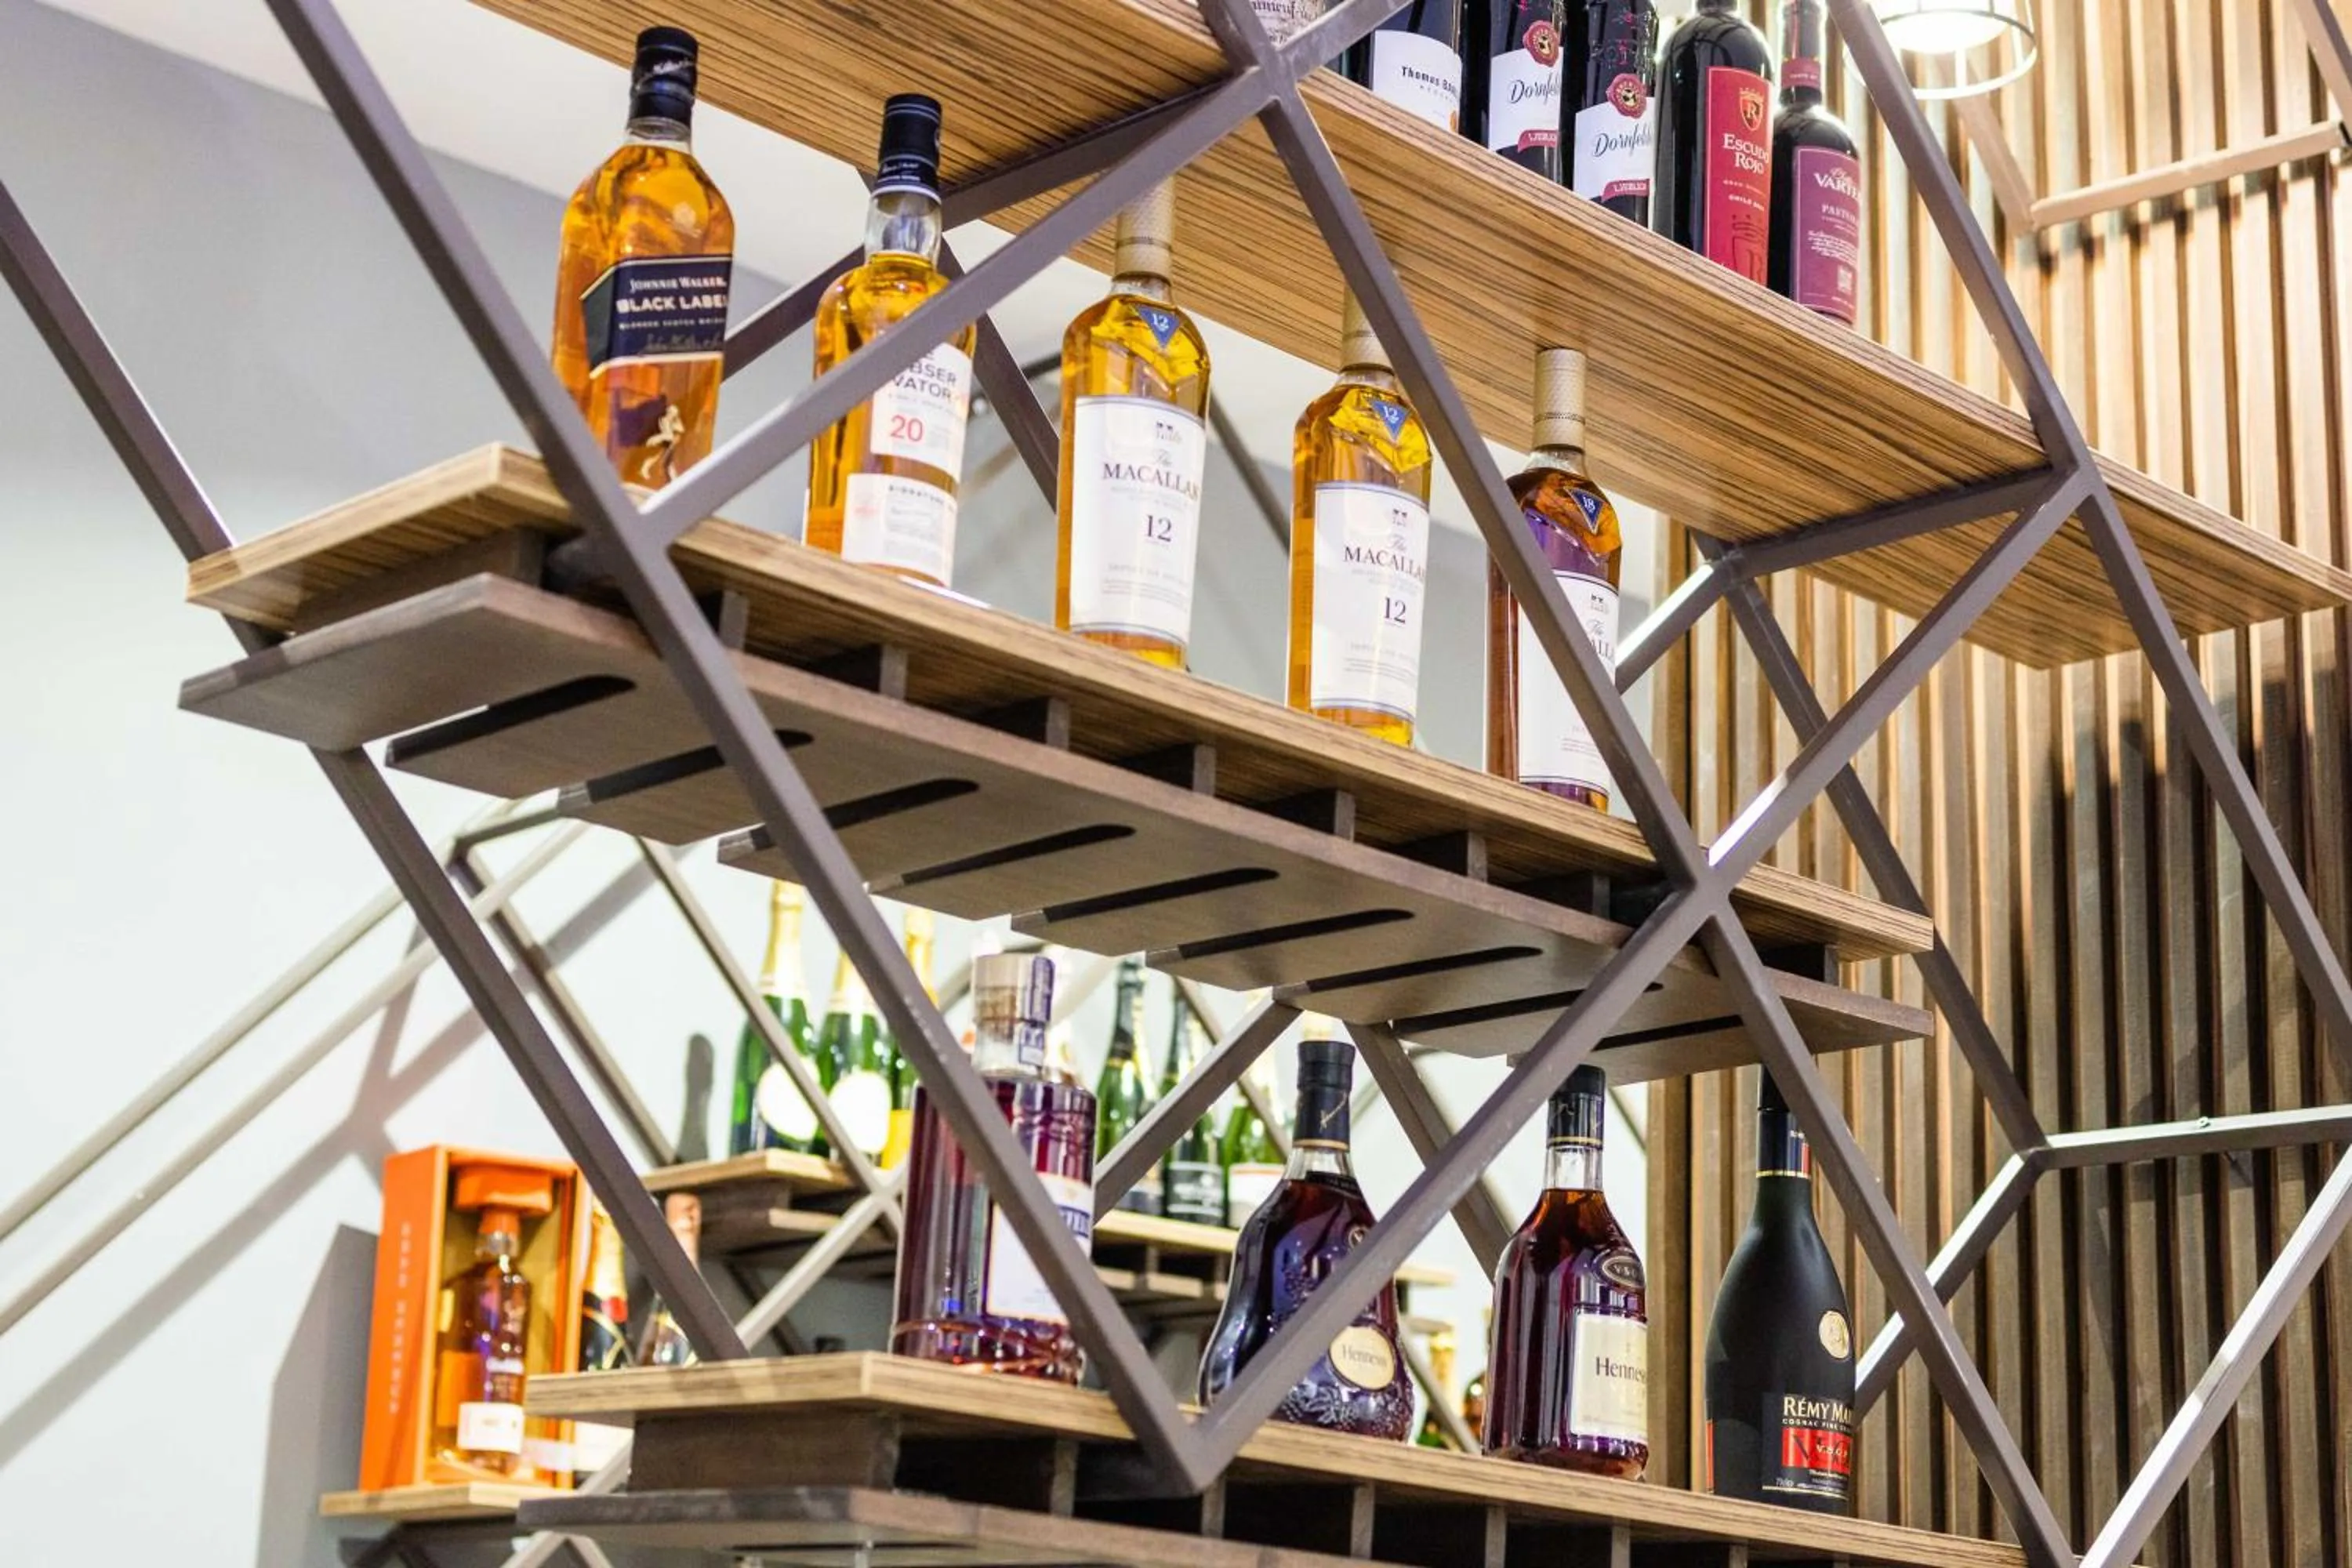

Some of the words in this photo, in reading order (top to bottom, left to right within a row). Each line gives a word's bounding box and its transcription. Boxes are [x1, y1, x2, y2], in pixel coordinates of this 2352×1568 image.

[1402, 66, 1439, 86] Thomas
[1722, 132, 1769, 164] ESCUDO
[1734, 151, 1764, 175] ROJO
[616, 297, 676, 314] BLACK
[909, 361, 957, 387] BSER
[890, 414, 924, 442] 20
[1146, 514, 1172, 543] 12
[1385, 596, 1406, 625] 12
[1782, 1395, 1830, 1420] RÉMY
